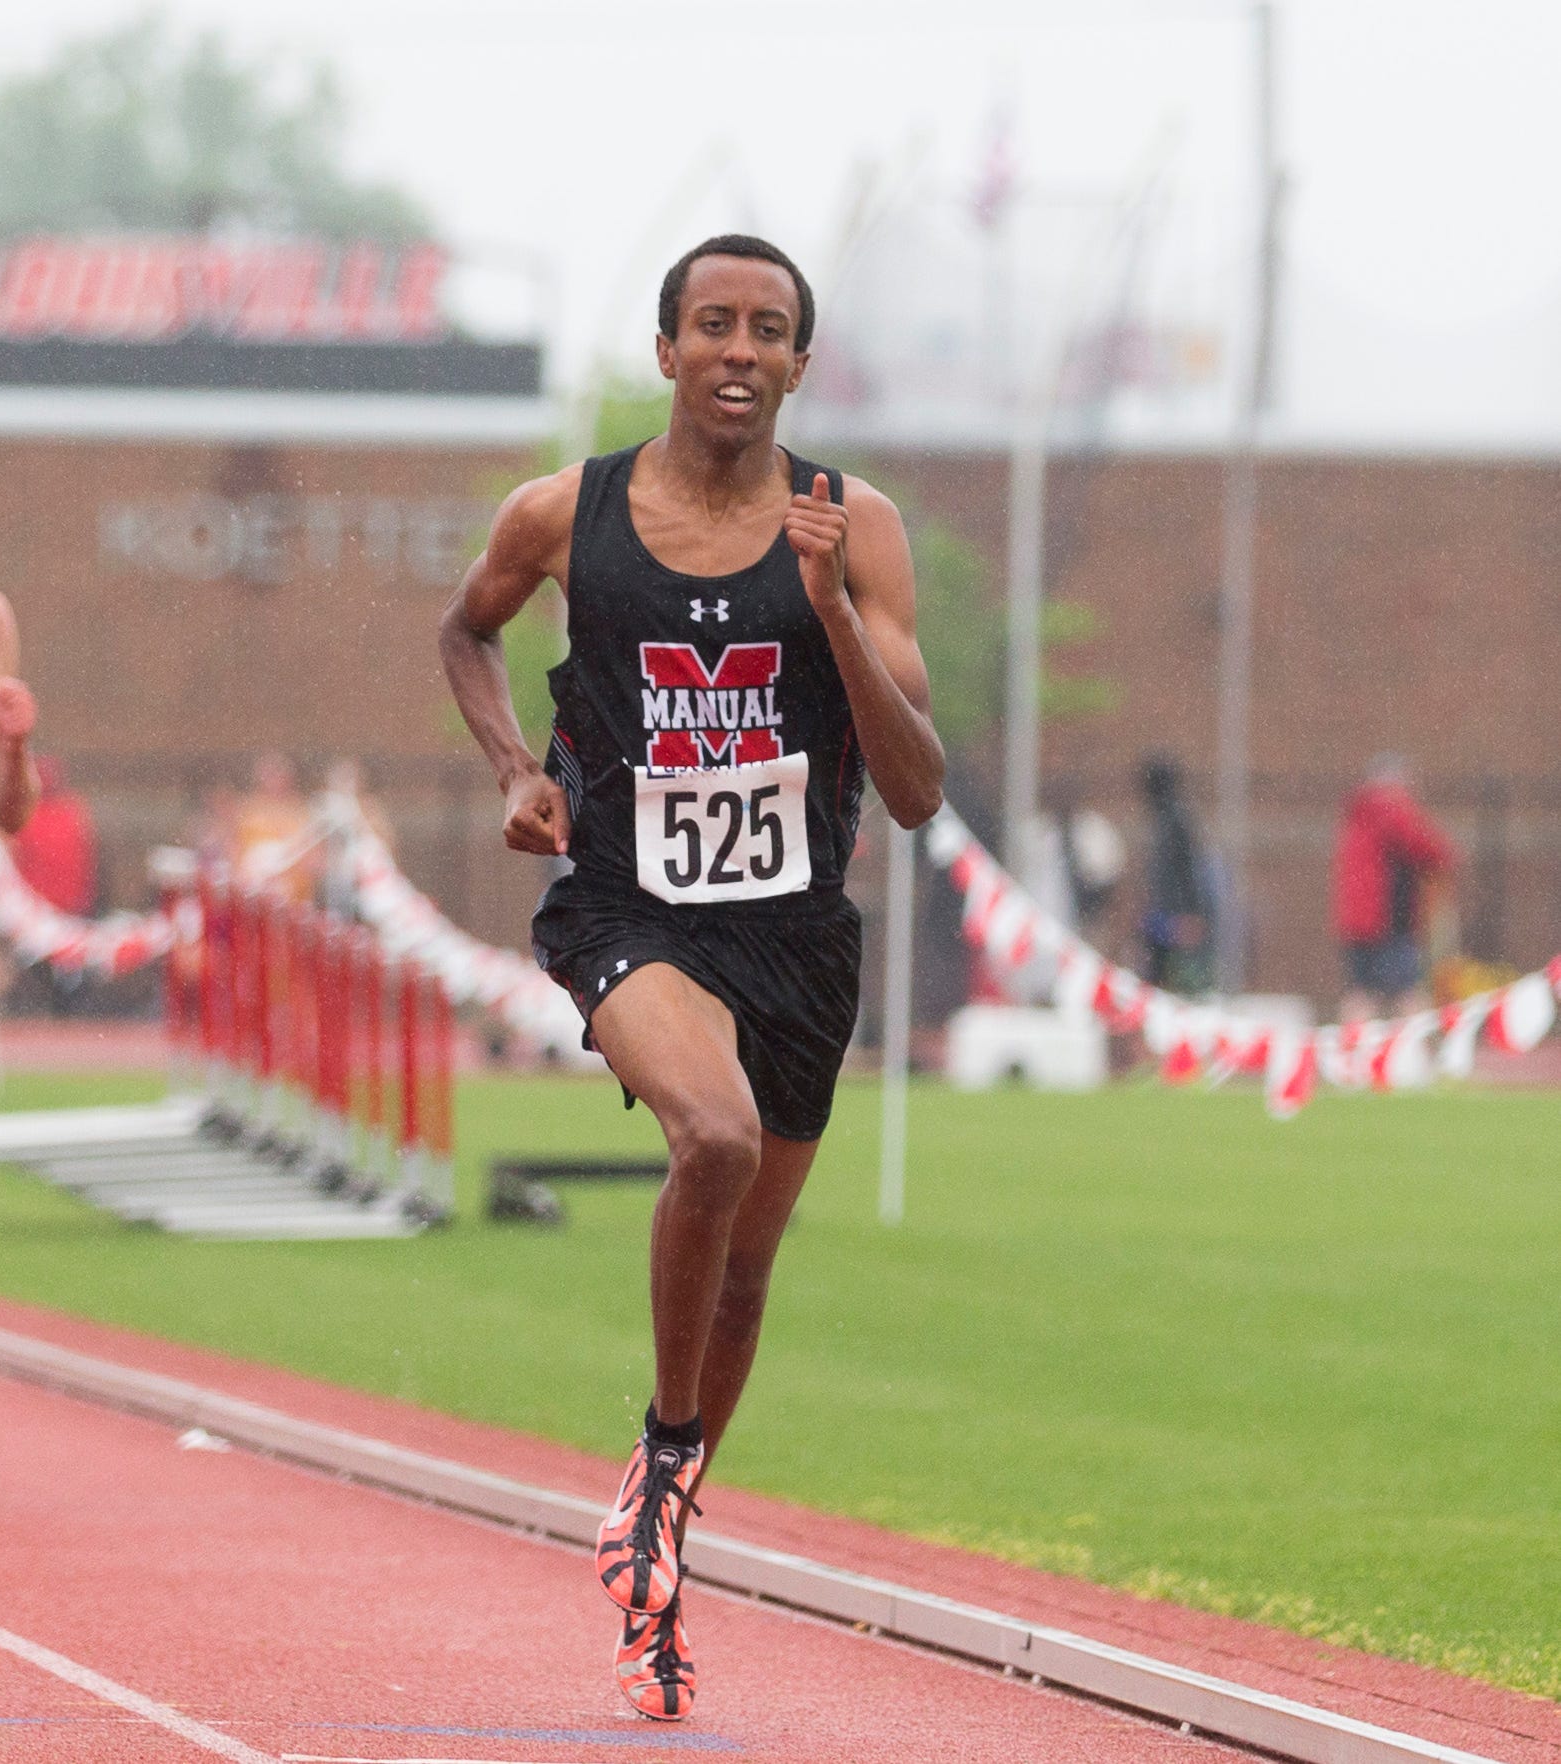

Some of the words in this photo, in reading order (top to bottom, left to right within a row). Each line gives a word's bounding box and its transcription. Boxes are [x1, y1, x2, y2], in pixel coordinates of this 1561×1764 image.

[96, 494, 492, 586] KOETTE
[641, 688, 782, 730] MANUAL
[665, 785, 784, 887] 525
